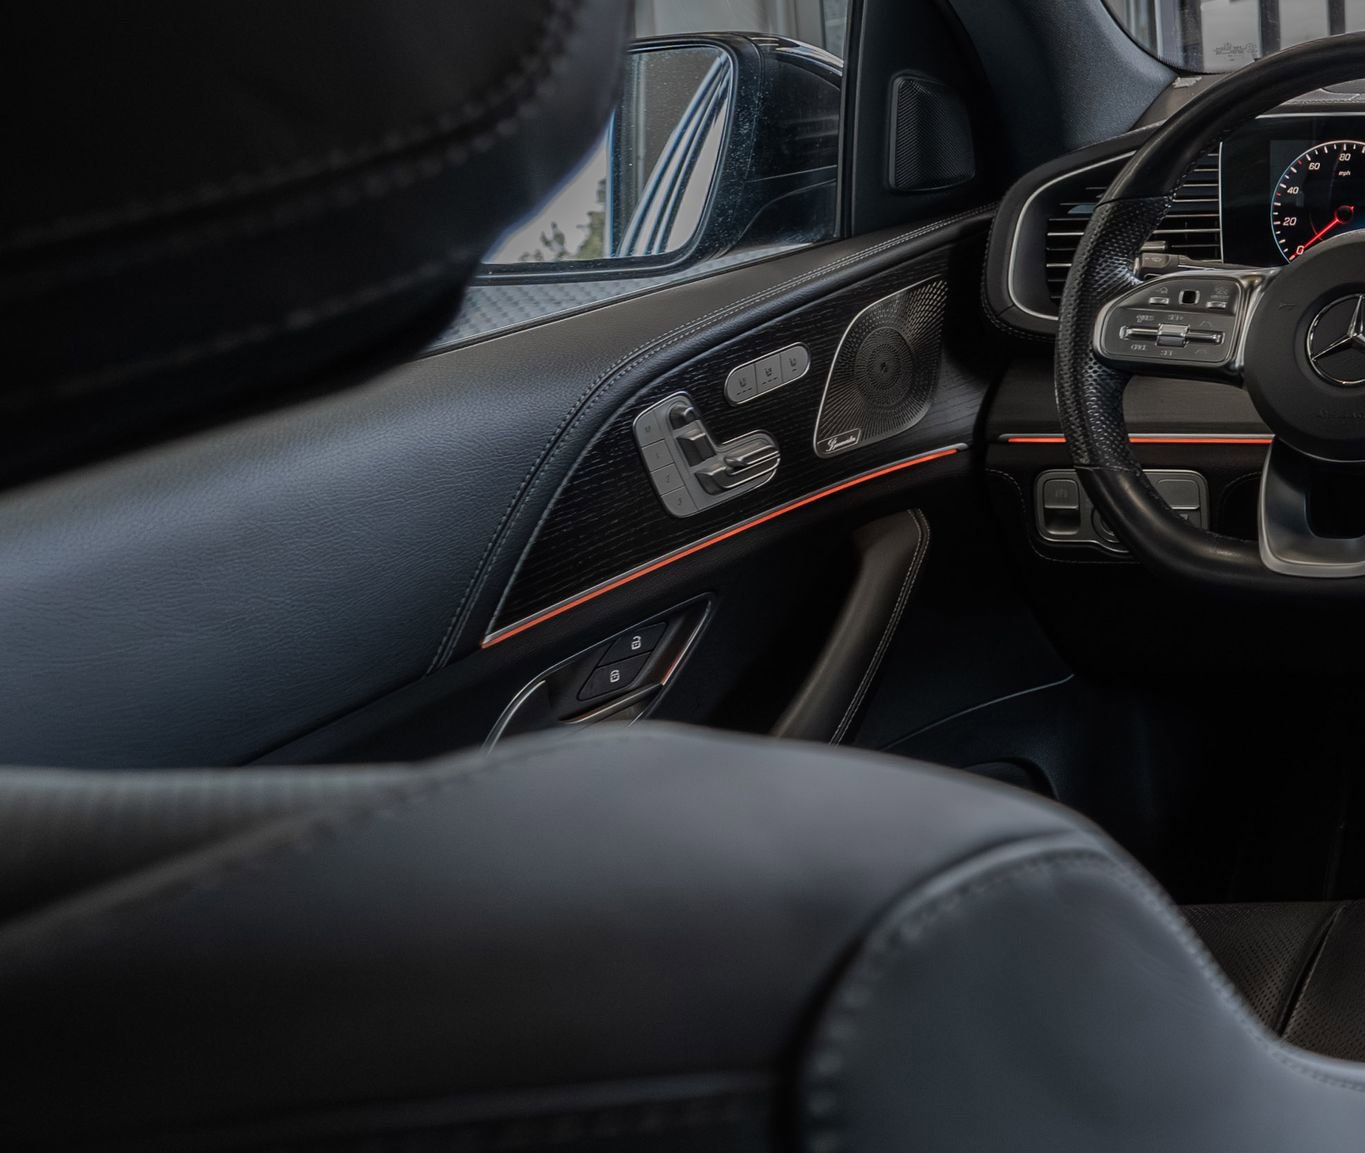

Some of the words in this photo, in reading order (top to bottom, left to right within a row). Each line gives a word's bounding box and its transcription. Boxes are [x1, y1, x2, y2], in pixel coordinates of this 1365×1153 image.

[1338, 153, 1351, 162] 80
[1308, 162, 1321, 170] 60
[1287, 186, 1299, 194] 40
[1282, 217, 1297, 226] 20
[1296, 245, 1304, 255] 0
